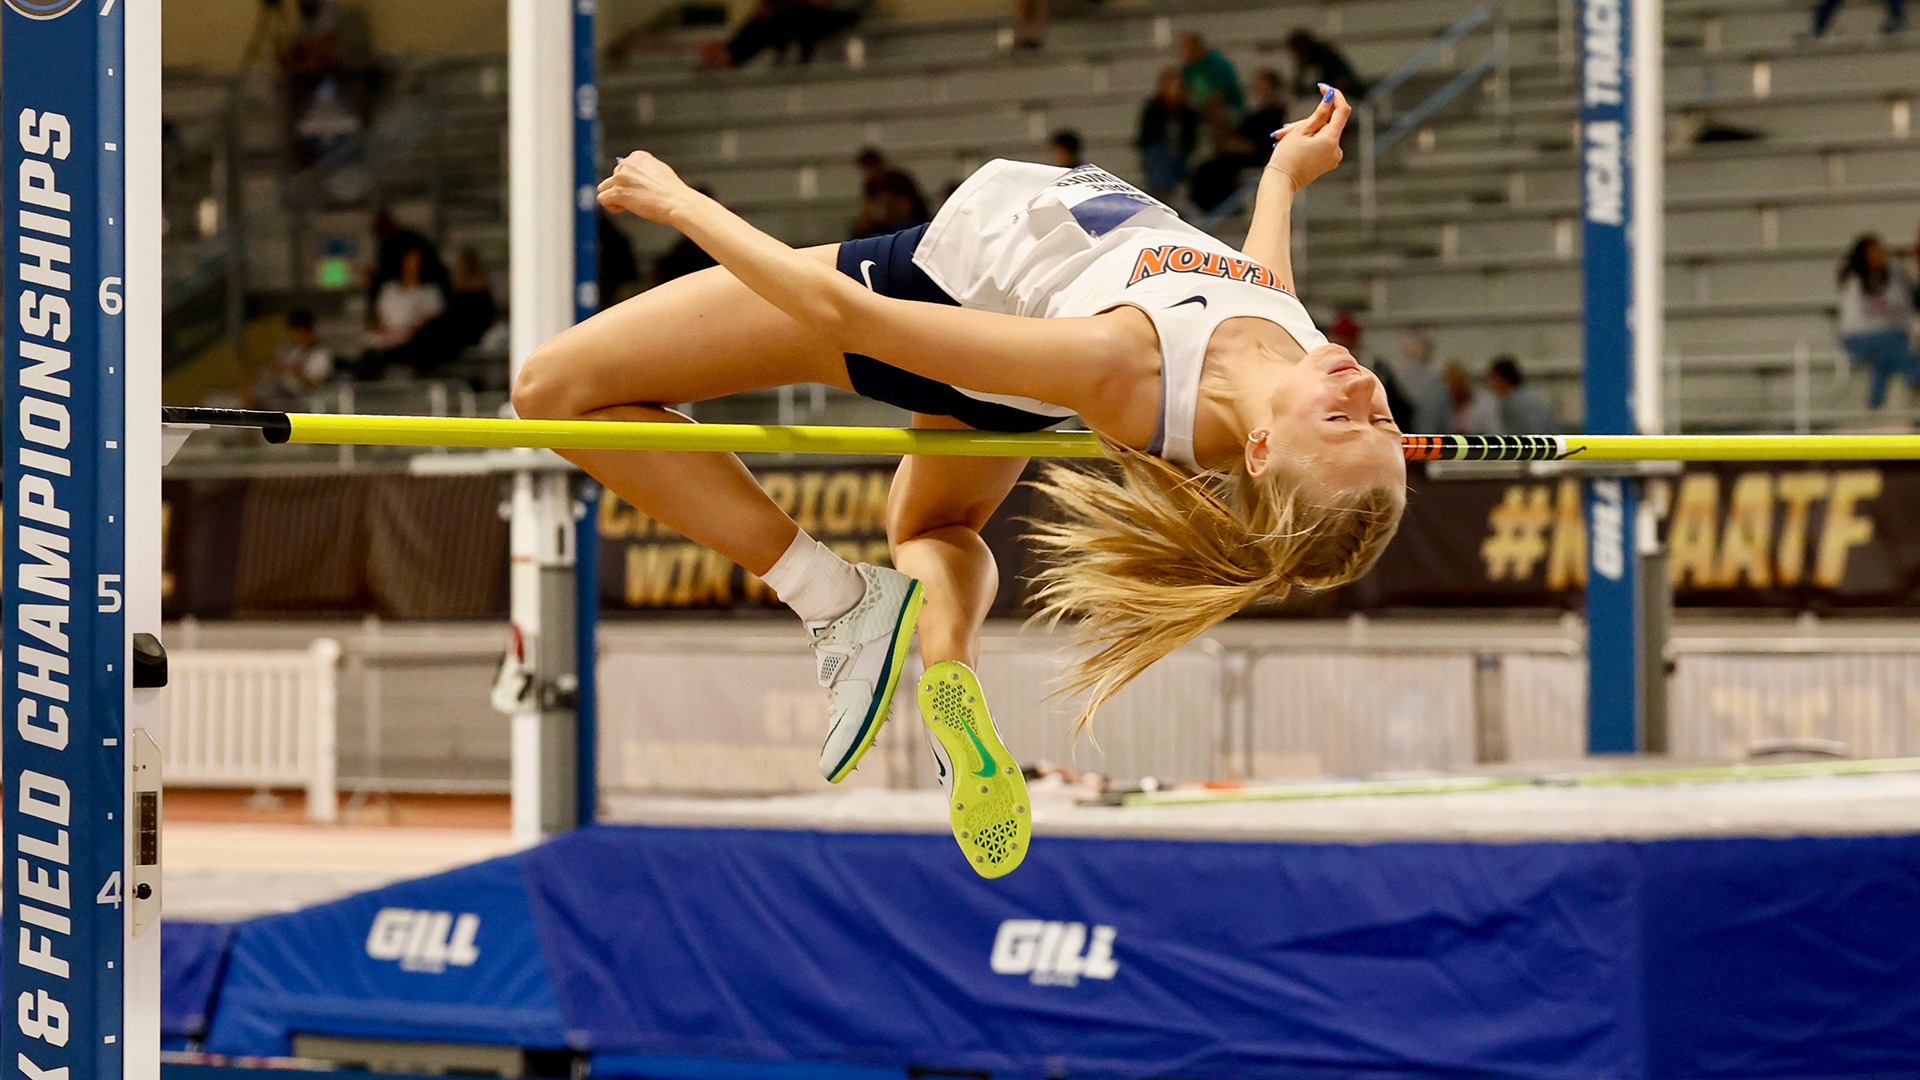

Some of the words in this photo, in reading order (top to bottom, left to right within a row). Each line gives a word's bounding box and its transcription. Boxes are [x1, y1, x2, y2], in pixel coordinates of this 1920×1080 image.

[1585, 120, 1624, 226] NCAA
[99, 276, 123, 315] 6
[18, 107, 71, 751] CHAMPIONSHIPS
[1478, 470, 1884, 592] #NAATF
[98, 573, 122, 613] 5
[18, 769, 71, 979] FIELD
[96, 870, 122, 909] 4
[365, 907, 480, 966] GILL
[990, 919, 1120, 980] GILL
[18, 988, 70, 1048] &
